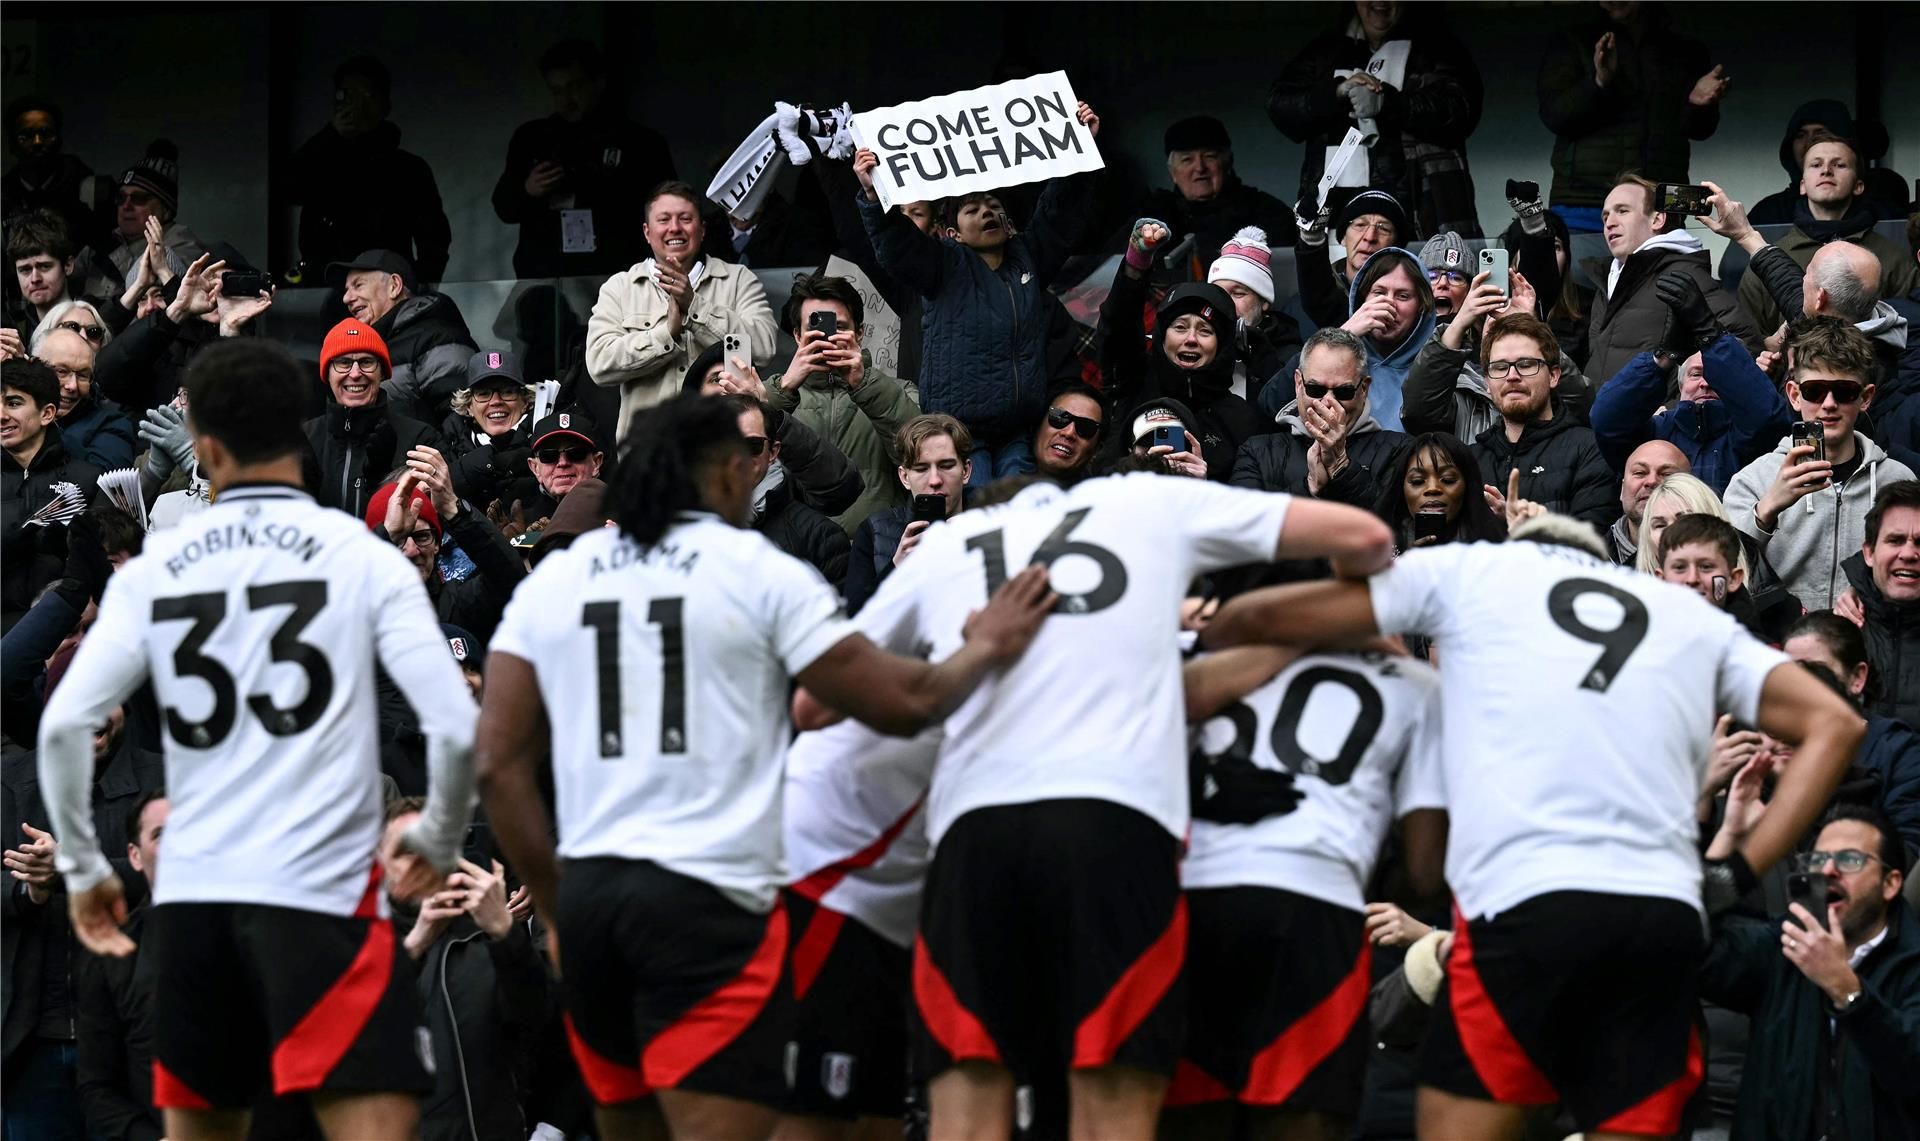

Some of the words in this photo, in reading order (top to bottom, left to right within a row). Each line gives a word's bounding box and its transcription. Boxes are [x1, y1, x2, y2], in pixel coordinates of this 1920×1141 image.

[877, 106, 998, 150] COME
[1004, 91, 1069, 127] ON
[886, 122, 1083, 188] FULHAM
[165, 523, 322, 578] ROBINSON
[965, 506, 1128, 615] 16
[152, 579, 334, 750] 33
[581, 597, 686, 757] 11
[1547, 577, 1649, 693] 9
